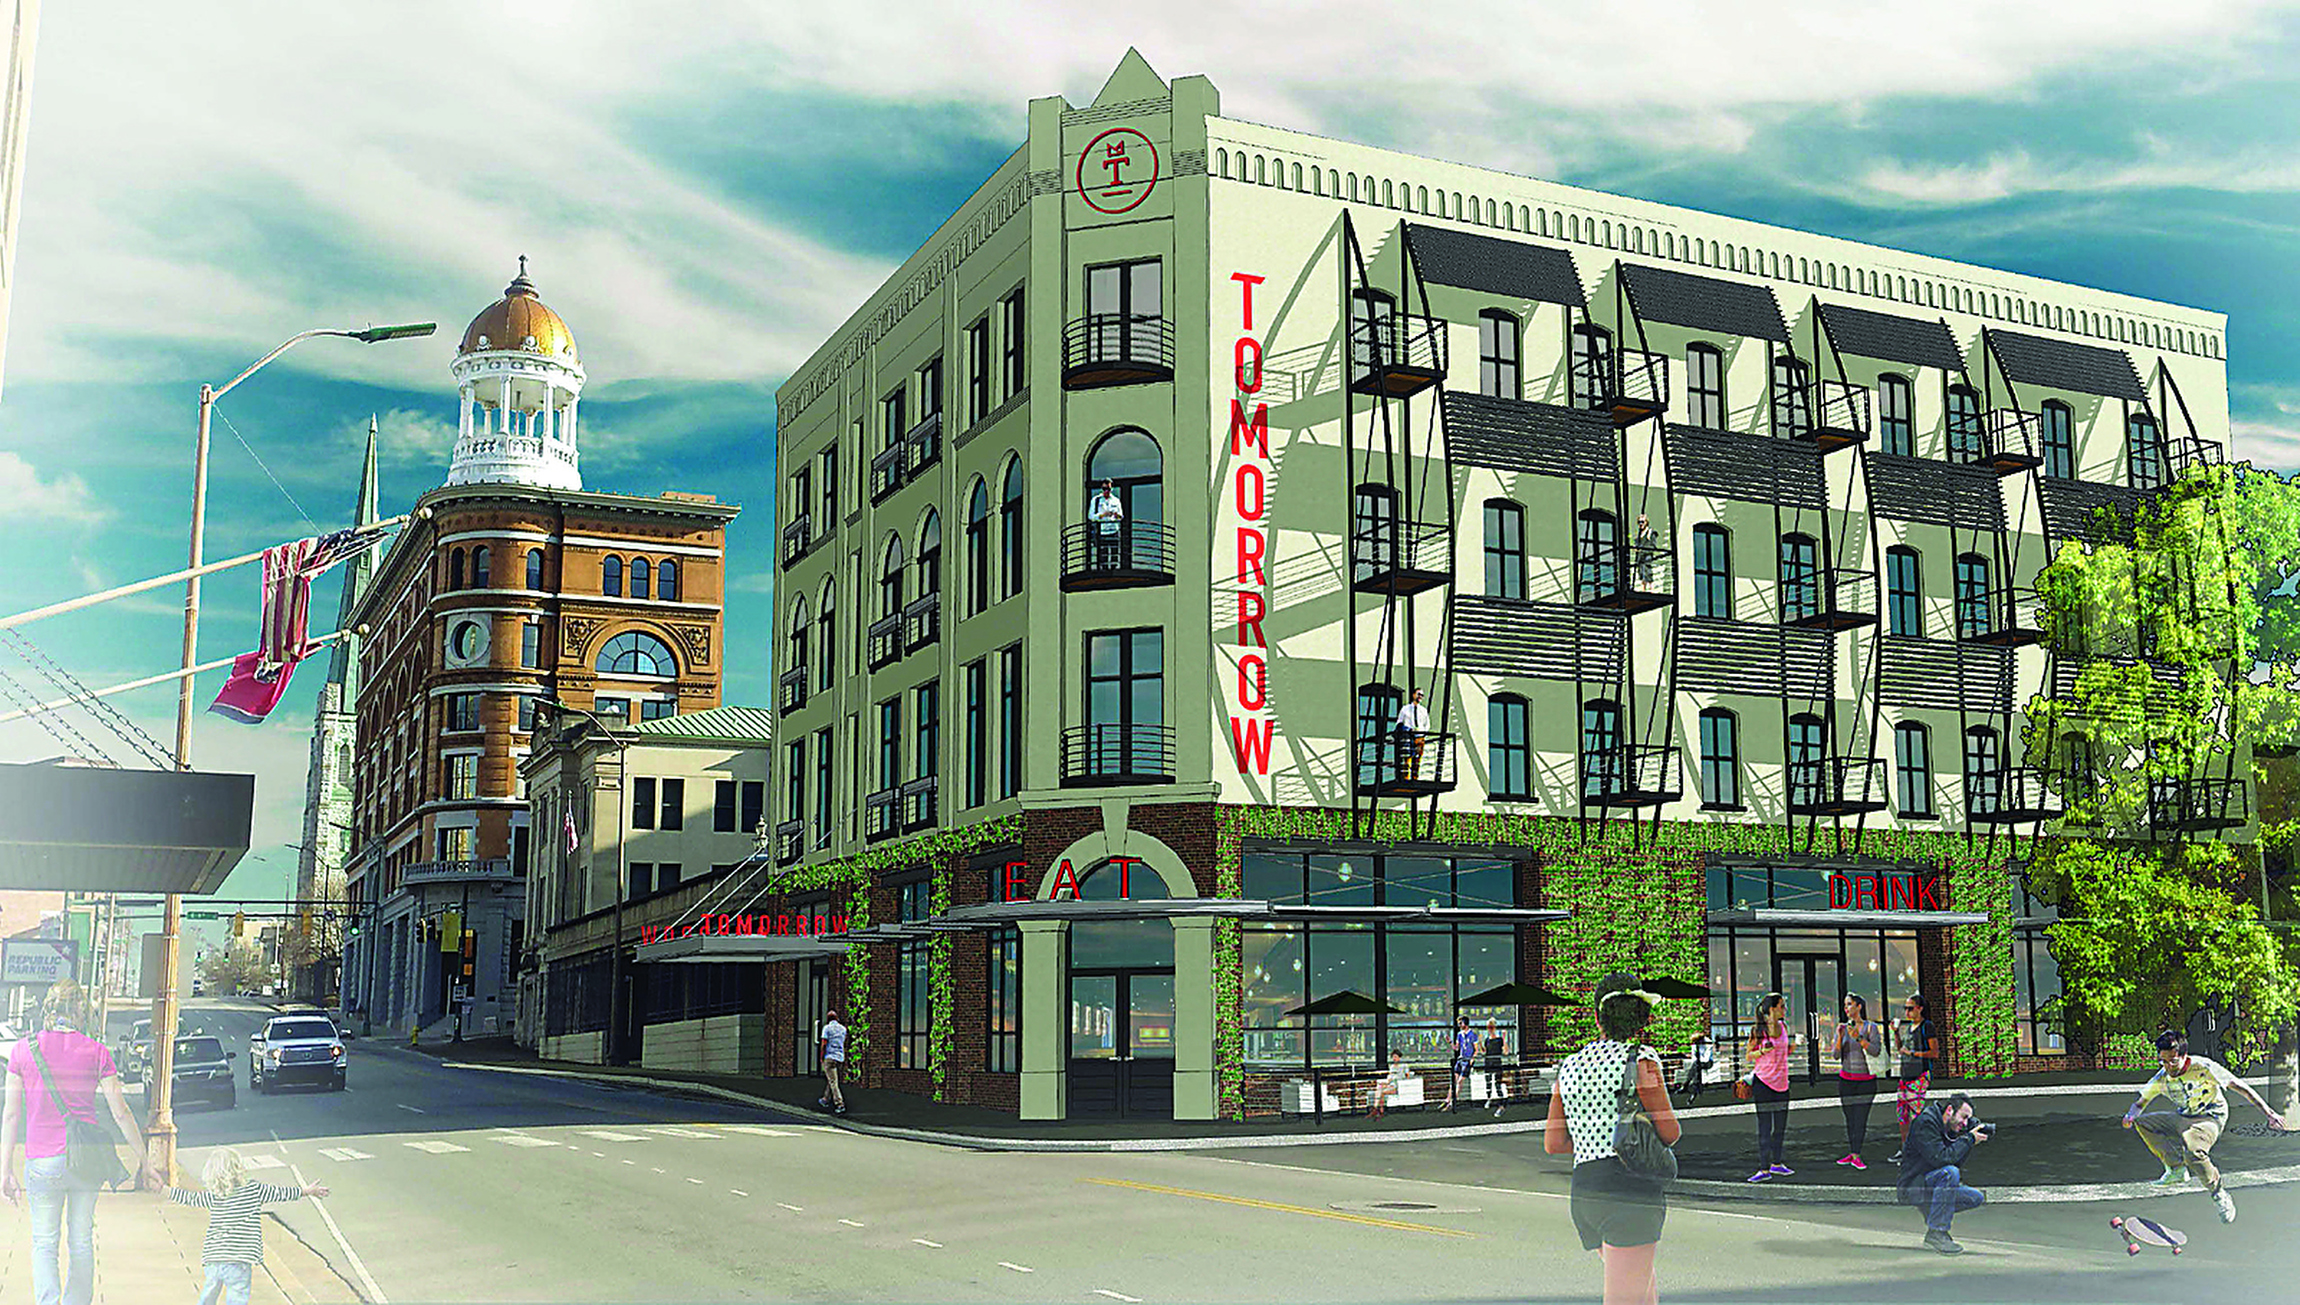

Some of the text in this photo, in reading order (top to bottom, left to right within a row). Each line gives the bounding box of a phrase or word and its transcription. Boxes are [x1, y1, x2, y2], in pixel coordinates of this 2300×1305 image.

[1230, 272, 1275, 775] TOMORROW
[1006, 859, 1140, 902] EAT
[1830, 875, 1939, 910] DRINK
[700, 913, 849, 938] TOMORROW
[8, 954, 62, 965] REPUBLIC
[8, 965, 57, 975] PARKING
